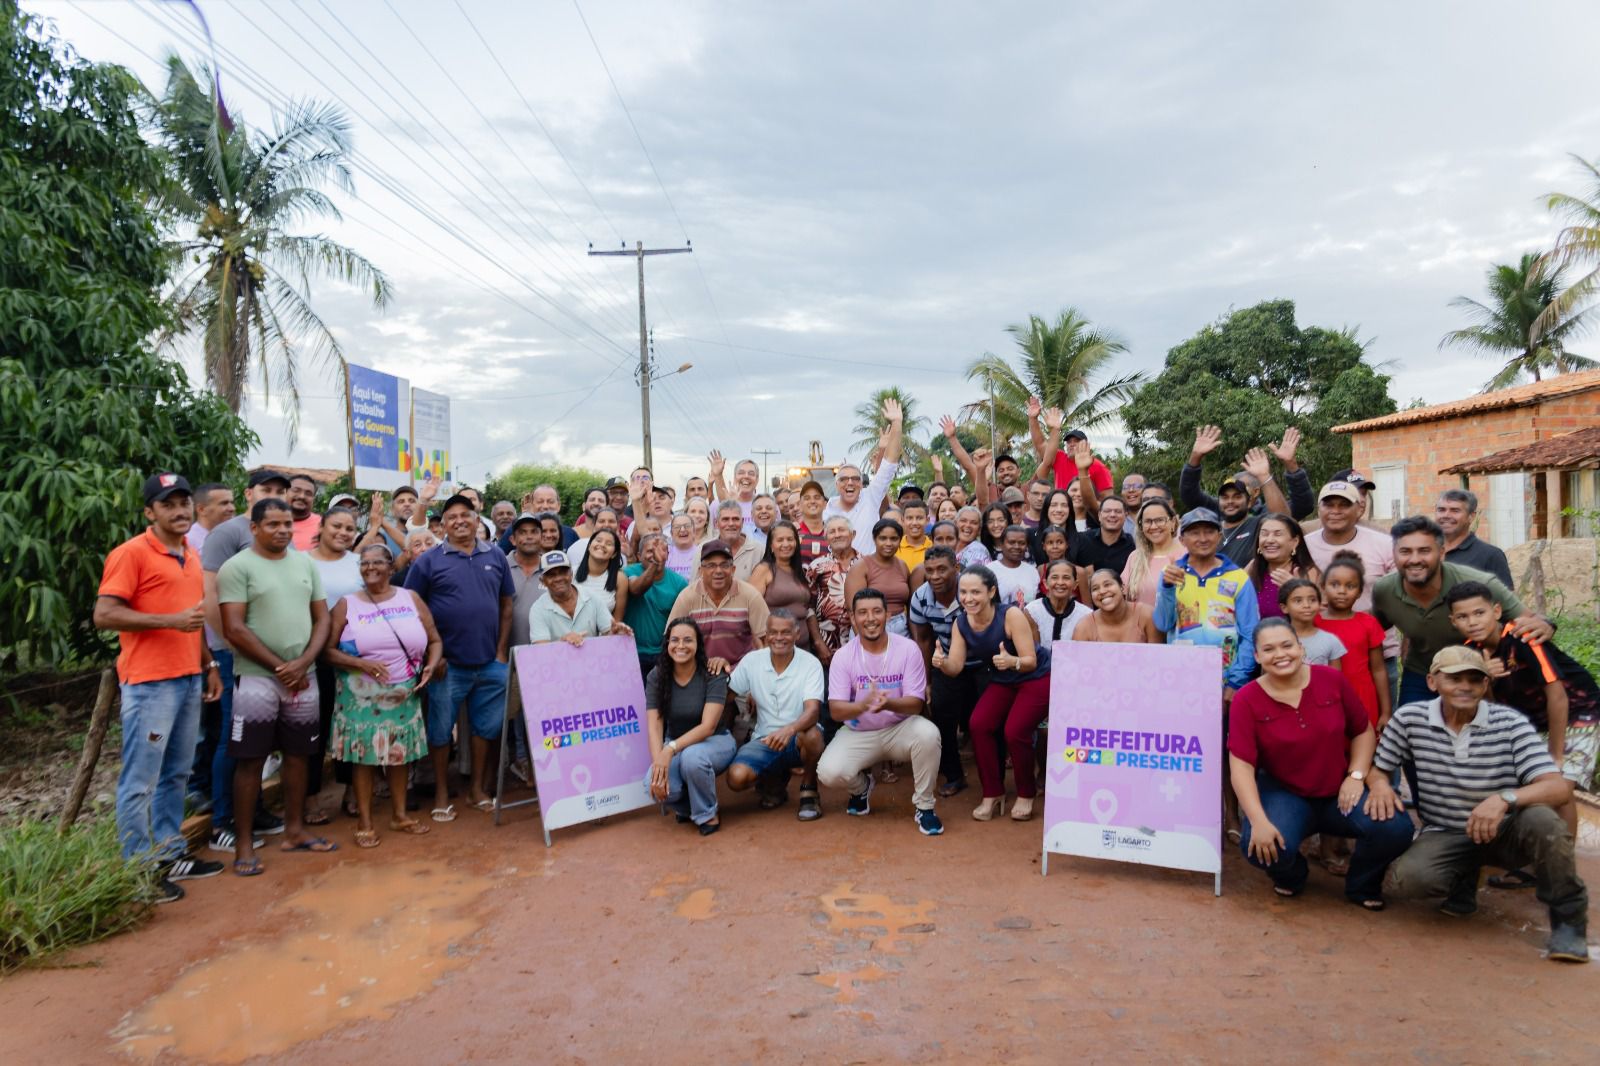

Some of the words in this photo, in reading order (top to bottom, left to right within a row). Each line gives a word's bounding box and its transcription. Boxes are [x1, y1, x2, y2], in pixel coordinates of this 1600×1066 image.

[352, 384, 370, 399] Aqui
[371, 389, 386, 404] tem
[353, 400, 386, 418] trabalho
[354, 417, 365, 430] do
[365, 418, 395, 436] Governo
[355, 432, 383, 448] Federal
[541, 705, 638, 736] PREFEITURA
[582, 721, 640, 743] PRESENTE
[1065, 726, 1203, 755] PREFEITURA
[1116, 752, 1203, 772] PRESENTE
[1117, 836, 1151, 847] LAGARTO
